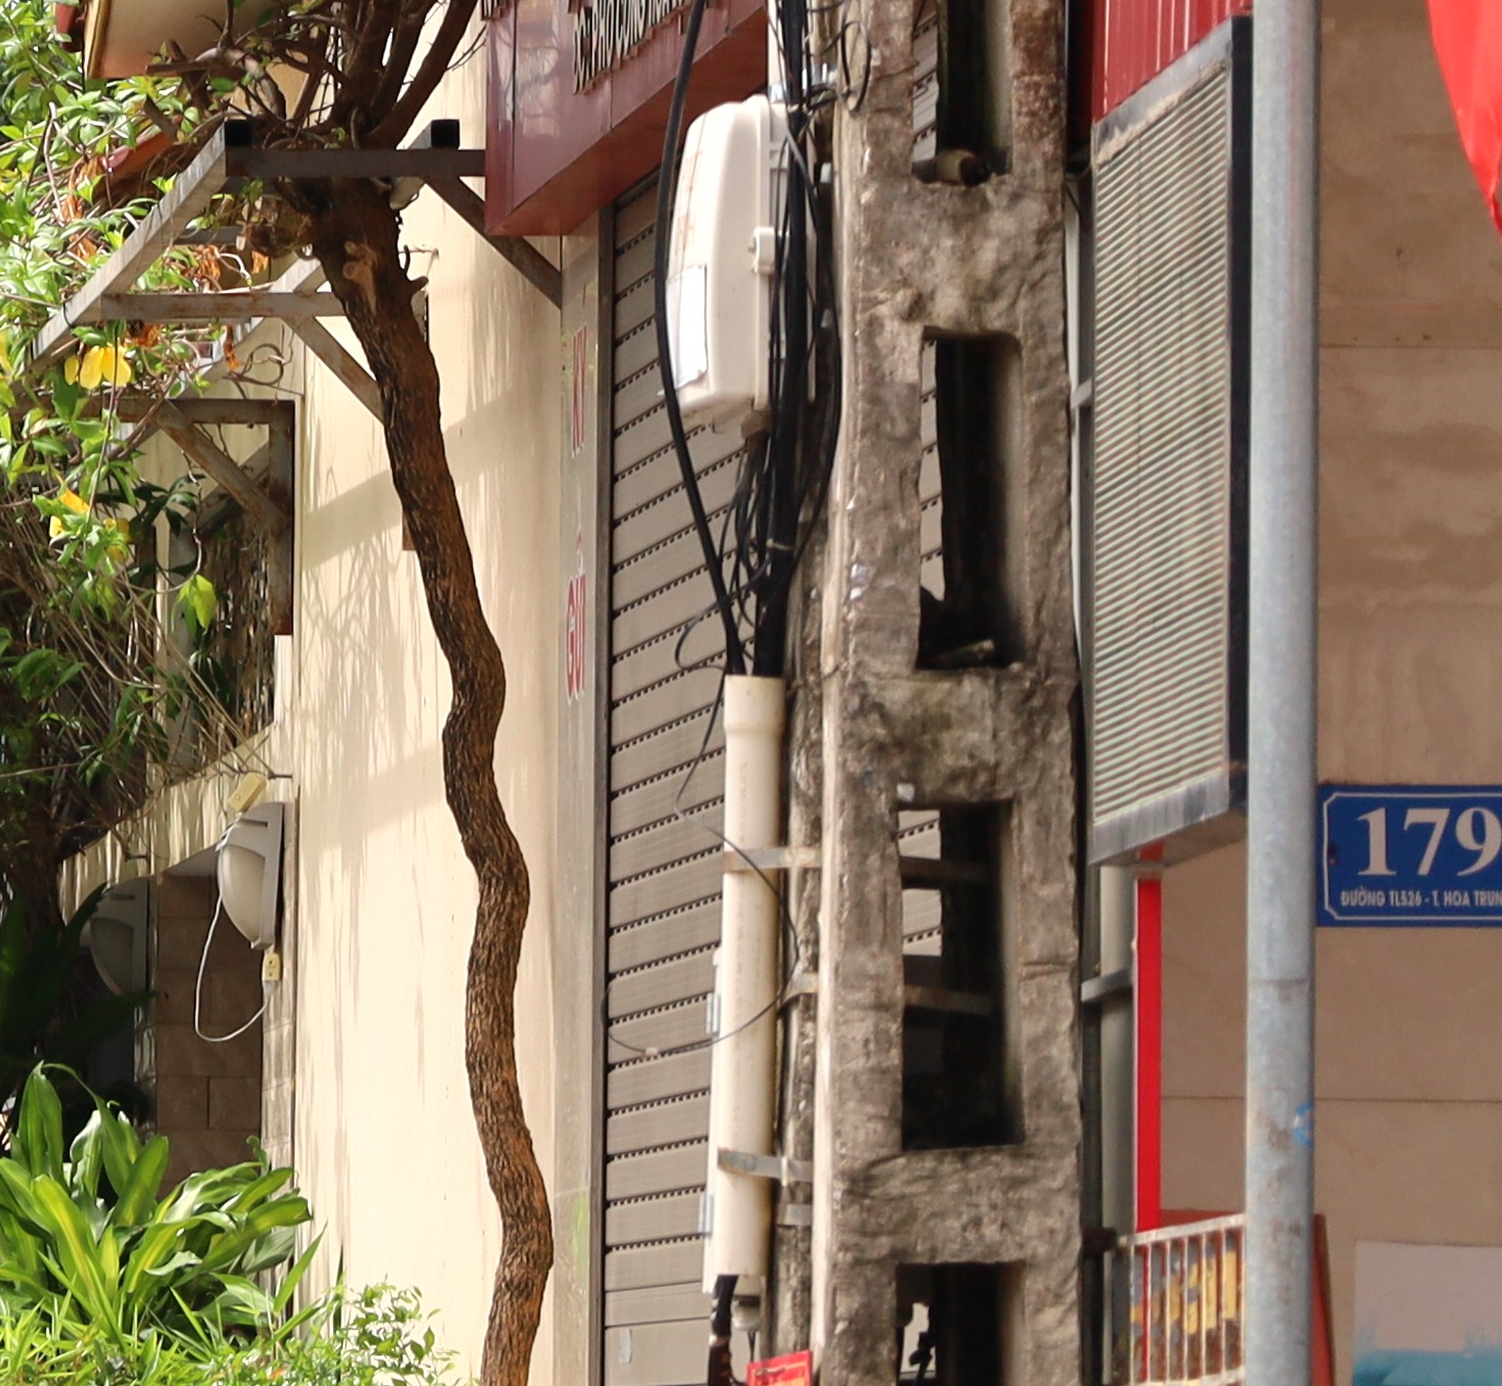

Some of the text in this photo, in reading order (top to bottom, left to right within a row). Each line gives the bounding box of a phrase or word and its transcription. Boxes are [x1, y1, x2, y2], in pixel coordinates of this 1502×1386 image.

[1356, 807, 1502, 876] 179
[1341, 886, 1386, 906] ĐƯỜNG
[1389, 890, 1421, 906] TL526
